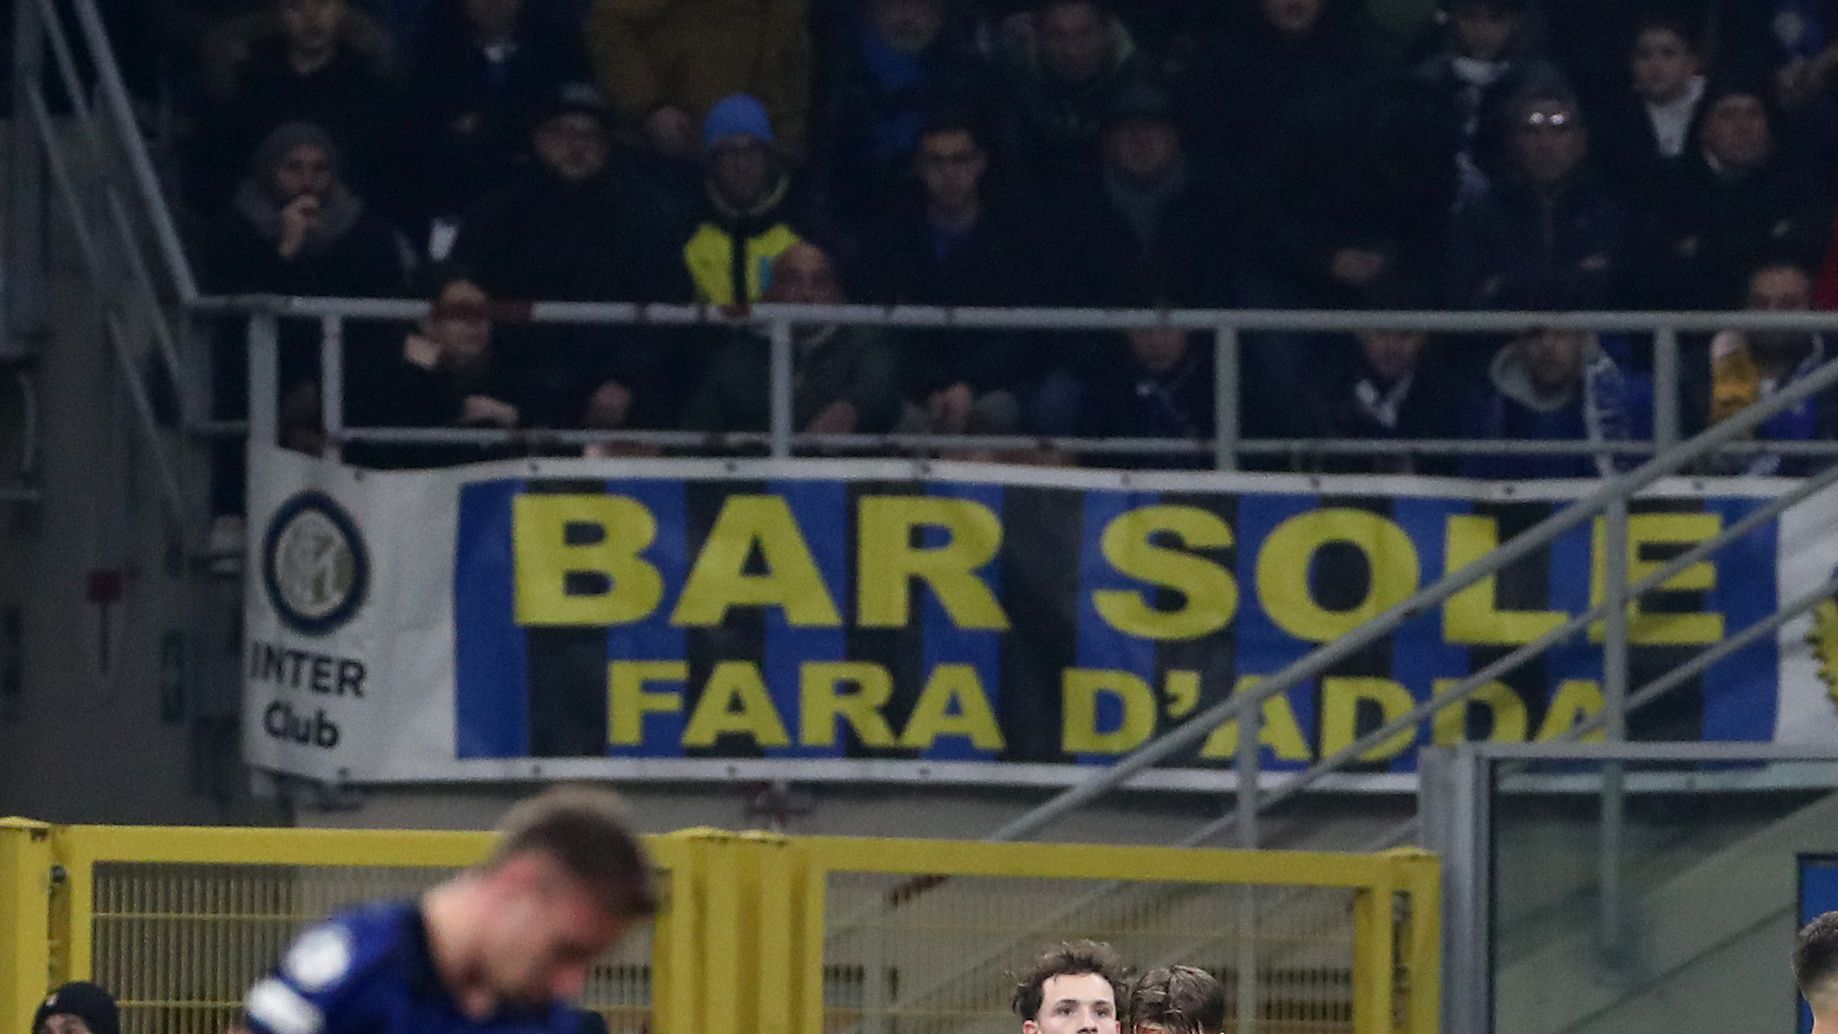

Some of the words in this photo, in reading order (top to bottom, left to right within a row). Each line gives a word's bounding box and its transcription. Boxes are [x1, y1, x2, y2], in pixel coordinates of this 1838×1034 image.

[511, 493, 1011, 630] BAR
[1092, 504, 1725, 646] SOLE
[251, 639, 366, 698] INTER
[608, 660, 1005, 749] FARA
[264, 700, 339, 748] Club
